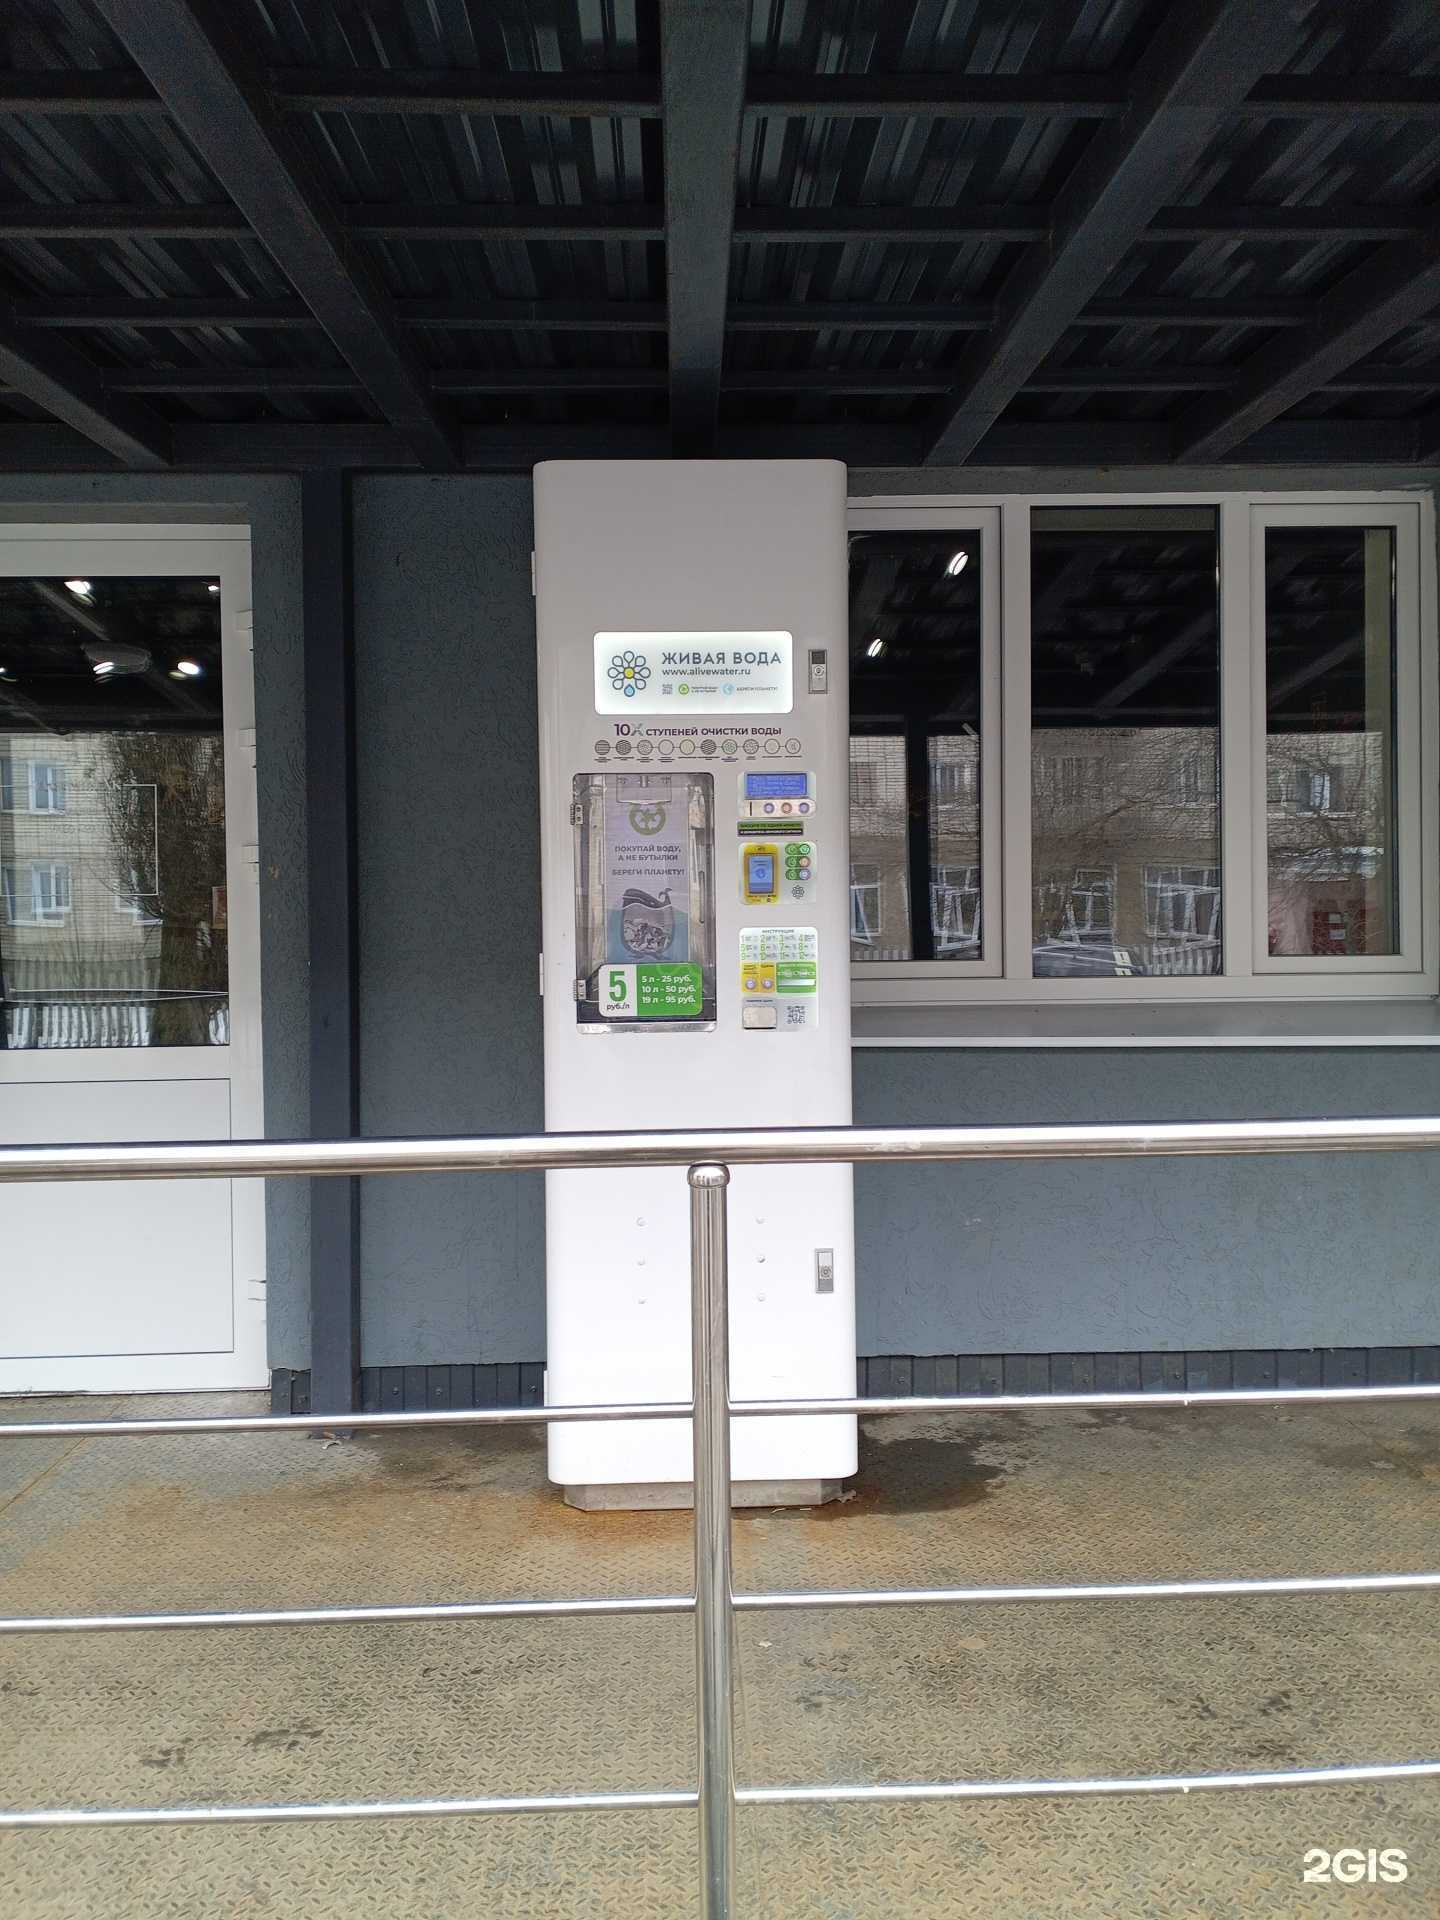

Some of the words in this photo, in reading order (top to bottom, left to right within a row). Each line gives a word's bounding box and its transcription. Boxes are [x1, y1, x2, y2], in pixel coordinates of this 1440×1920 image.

[662, 652, 726, 665] ЖИВАЯ
[733, 652, 782, 666] ВОДА
[662, 667, 751, 676] www.alivewater.ru
[646, 726, 698, 736] СТУПЕНЕЙ
[701, 727, 749, 736] ОЧИСТКИ
[751, 727, 782, 736] ВОДЫ
[615, 844, 655, 852] ПОКУПАЙ
[661, 975, 672, 983] 25
[673, 975, 692, 984] руб.
[609, 971, 627, 1002] 5
[678, 985, 696, 994] руб.
[677, 995, 696, 1004] руб.
